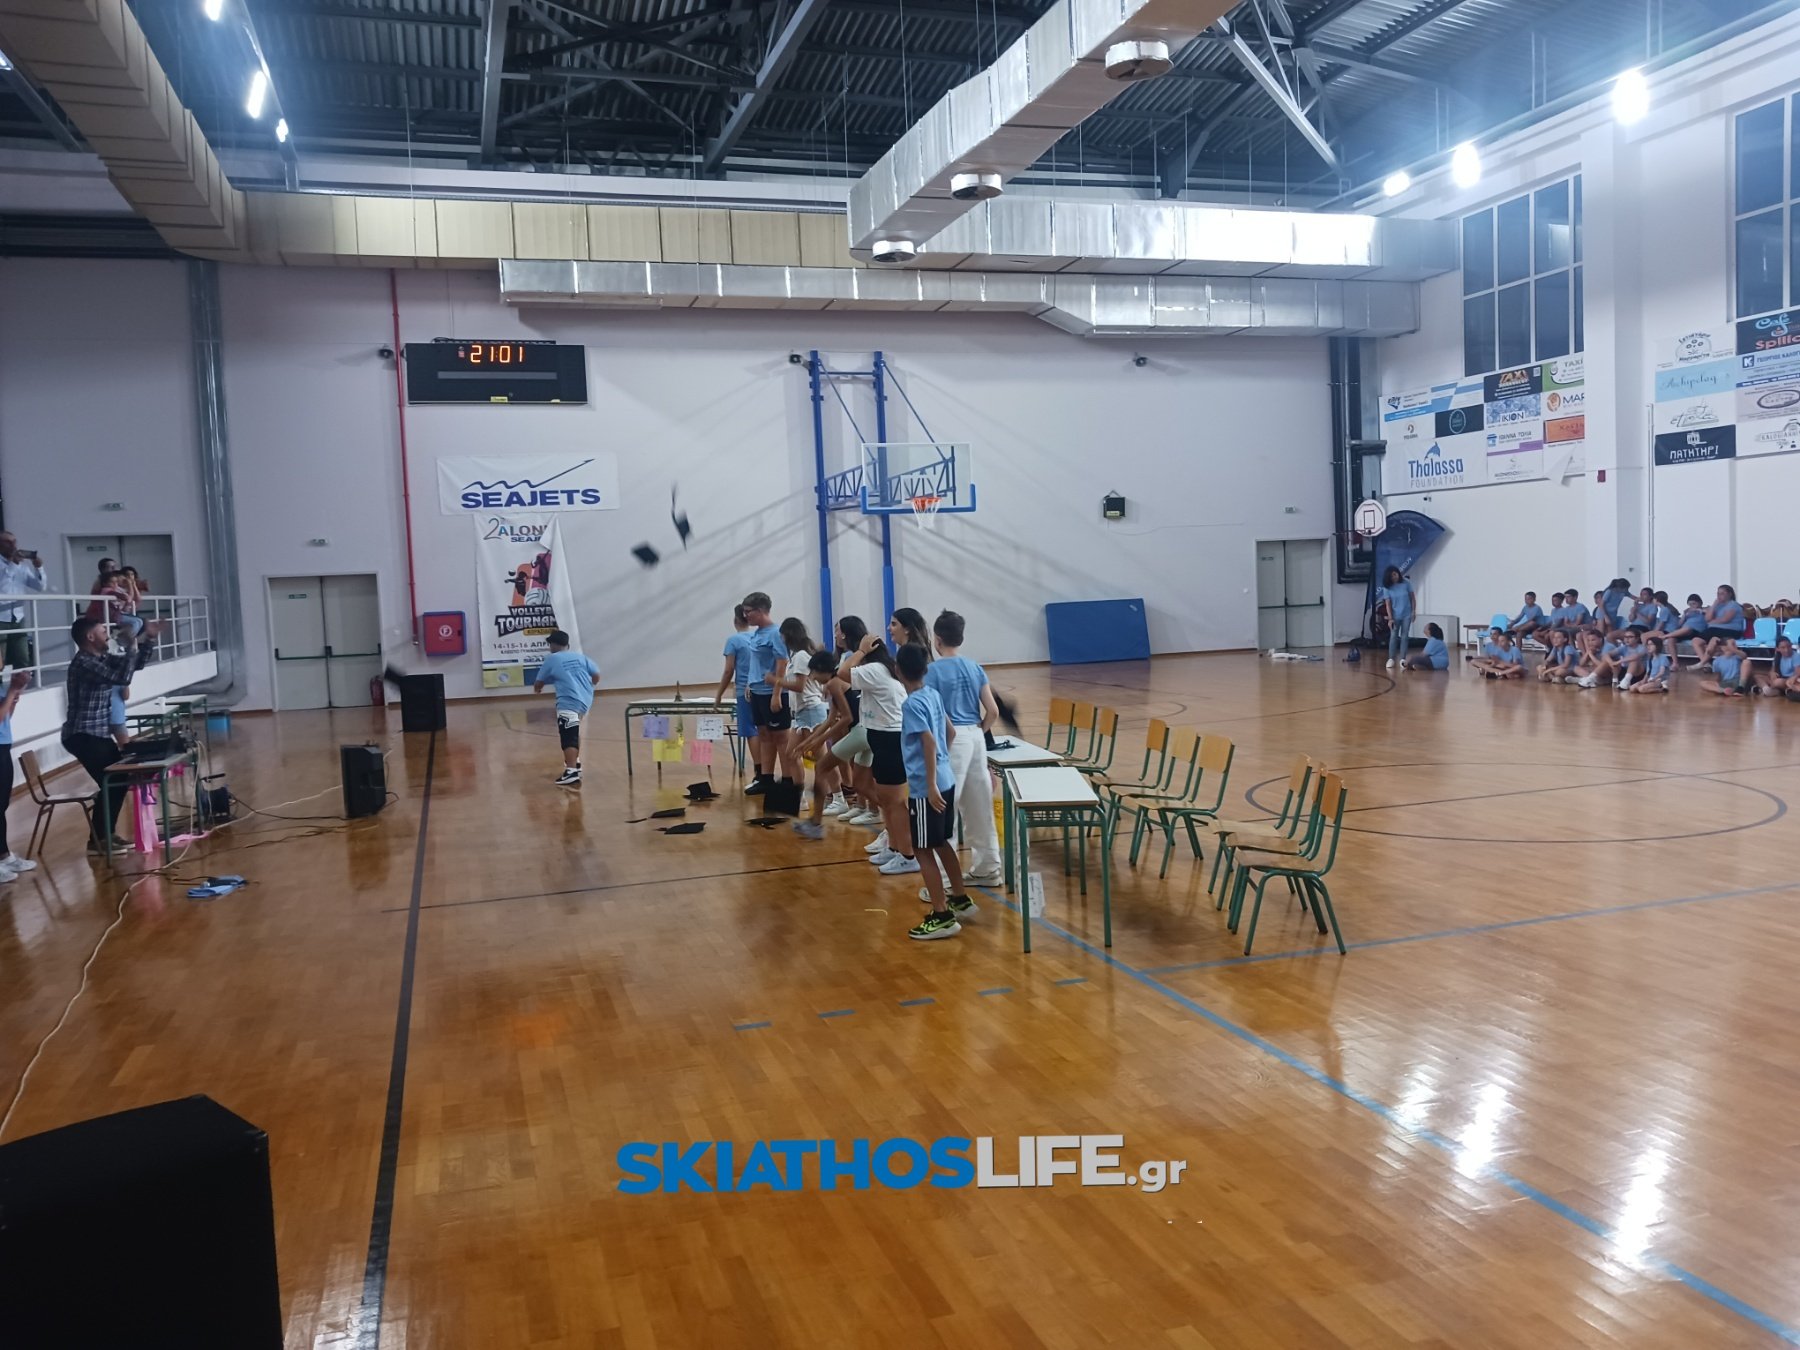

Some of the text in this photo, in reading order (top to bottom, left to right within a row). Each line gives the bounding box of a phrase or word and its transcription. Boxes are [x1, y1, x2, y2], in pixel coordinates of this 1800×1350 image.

[470, 345, 523, 363] 21:01
[1408, 458, 1464, 479] Thalassa
[1410, 475, 1464, 489] FOUNDATION
[461, 488, 601, 509] SEAJETS
